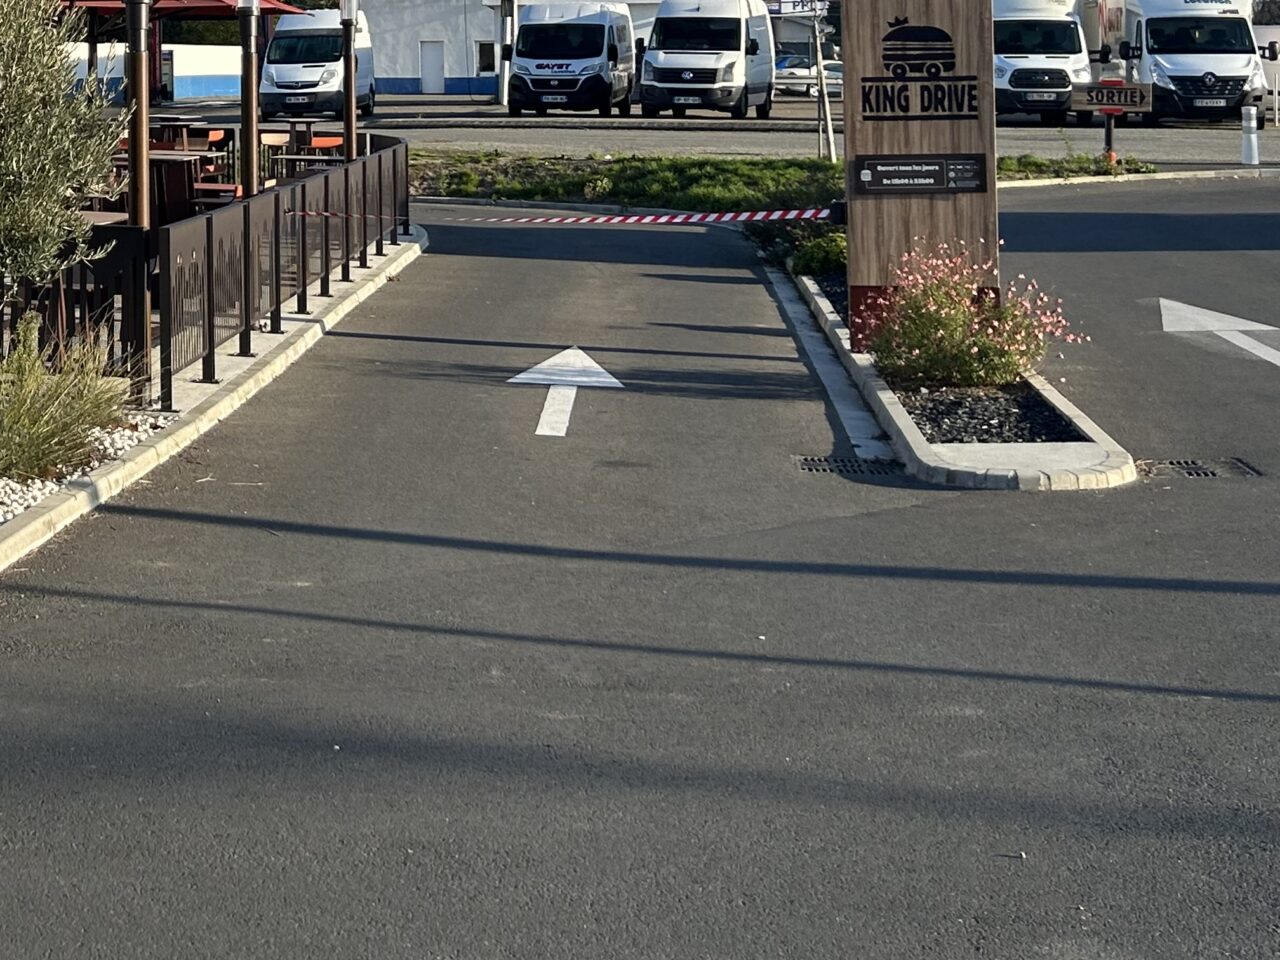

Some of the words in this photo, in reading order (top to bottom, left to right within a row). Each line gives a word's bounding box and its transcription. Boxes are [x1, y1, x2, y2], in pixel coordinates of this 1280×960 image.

[861, 85, 910, 113] KING
[920, 84, 978, 113] DRIVE
[1086, 90, 1139, 104] SORTIE
